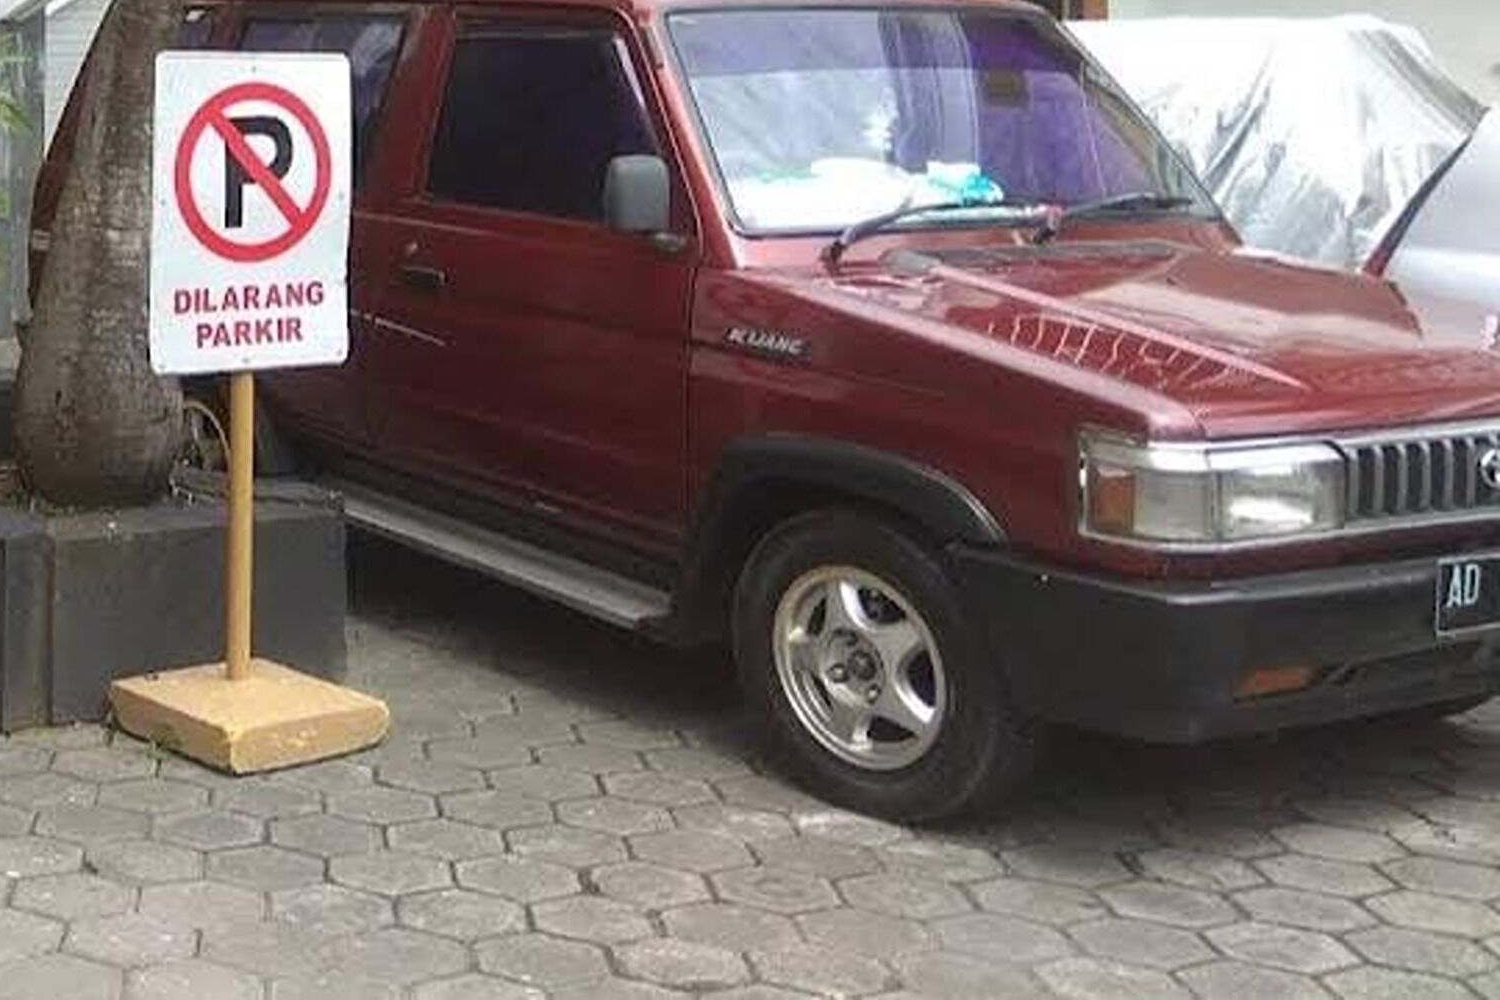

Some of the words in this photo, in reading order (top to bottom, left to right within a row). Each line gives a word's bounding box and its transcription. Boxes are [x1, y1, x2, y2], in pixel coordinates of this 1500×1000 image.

[173, 281, 324, 316] DILARANG
[196, 317, 303, 349] PARKIR
[1447, 564, 1480, 608] AD
